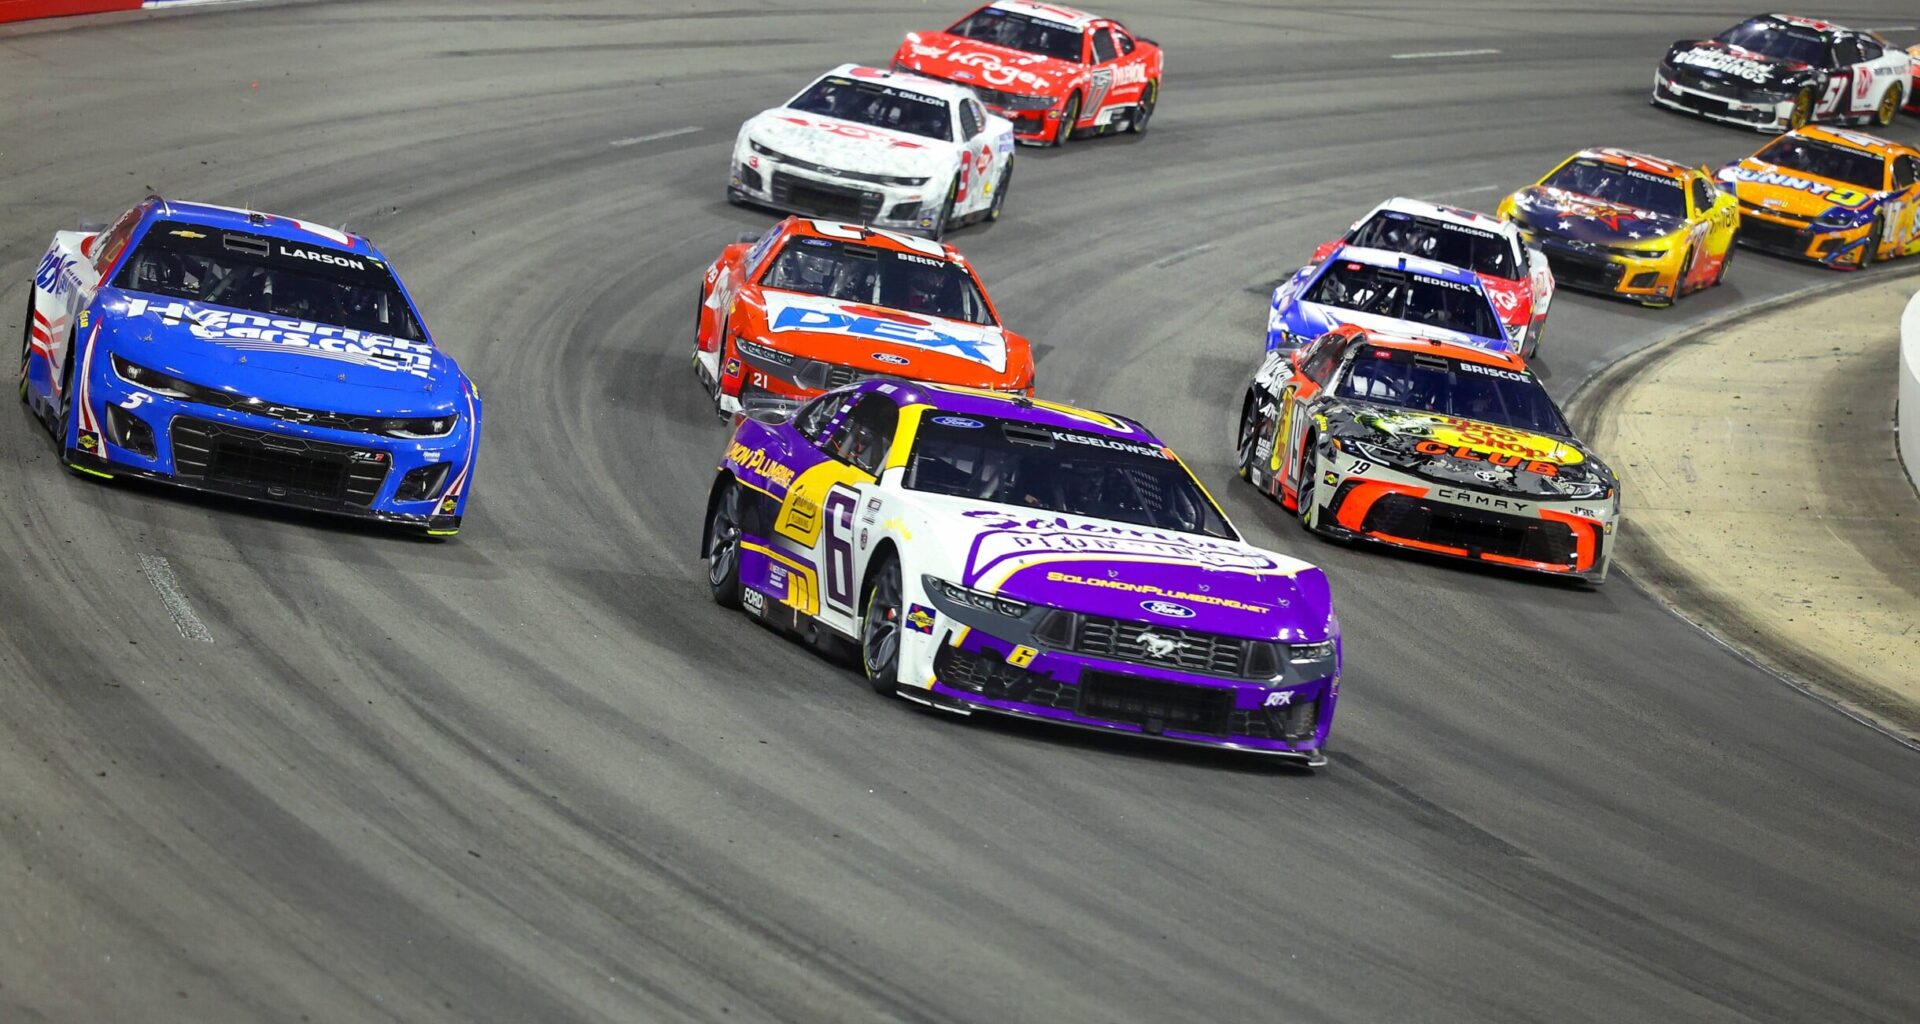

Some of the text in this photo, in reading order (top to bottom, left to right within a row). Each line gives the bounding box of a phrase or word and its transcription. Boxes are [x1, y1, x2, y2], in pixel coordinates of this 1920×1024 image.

[946, 52, 1050, 90] Kroger
[881, 88, 945, 107] A. DILLON
[749, 155, 759, 169] 3
[1442, 223, 1494, 239] GRAGSON
[280, 245, 364, 271] LARSON
[897, 253, 945, 269] BERRY
[1413, 275, 1470, 293] REDDICK
[772, 305, 995, 364] DEX
[753, 372, 768, 389] 21
[1459, 362, 1532, 384] BRISCOE
[119, 391, 153, 409] 5
[1345, 459, 1371, 475] 19
[1414, 439, 1559, 477] CLUB
[1438, 488, 1529, 511] CAMRY
[823, 489, 858, 611] 6
[744, 587, 764, 609] FORD
[1046, 571, 1271, 615] SOLOMONPLUMBING.NET
